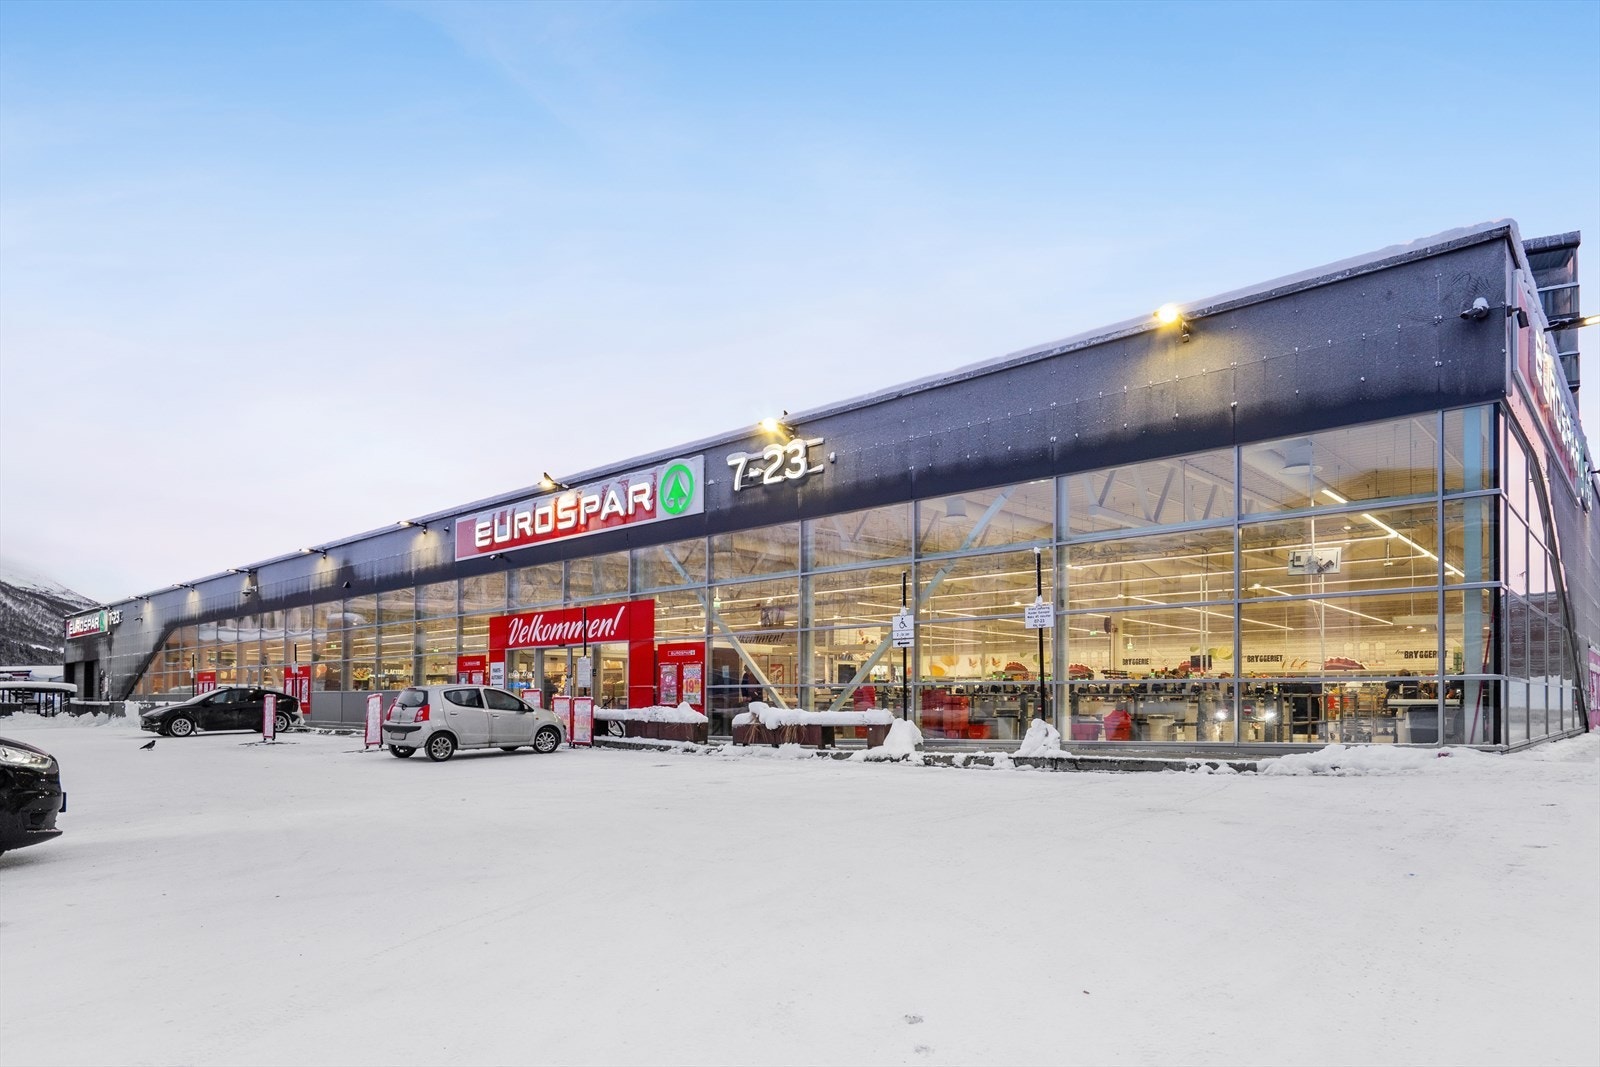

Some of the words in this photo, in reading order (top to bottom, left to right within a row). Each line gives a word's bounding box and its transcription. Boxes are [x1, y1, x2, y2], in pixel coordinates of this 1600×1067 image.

[727, 440, 808, 491] 7-23
[475, 482, 654, 548] EUROSPAR
[69, 616, 100, 635] EUROSPAR
[508, 606, 626, 646] Velkommen!
[1247, 654, 1283, 662] BRYGGERIET
[1404, 650, 1448, 659] BRYGGERT
